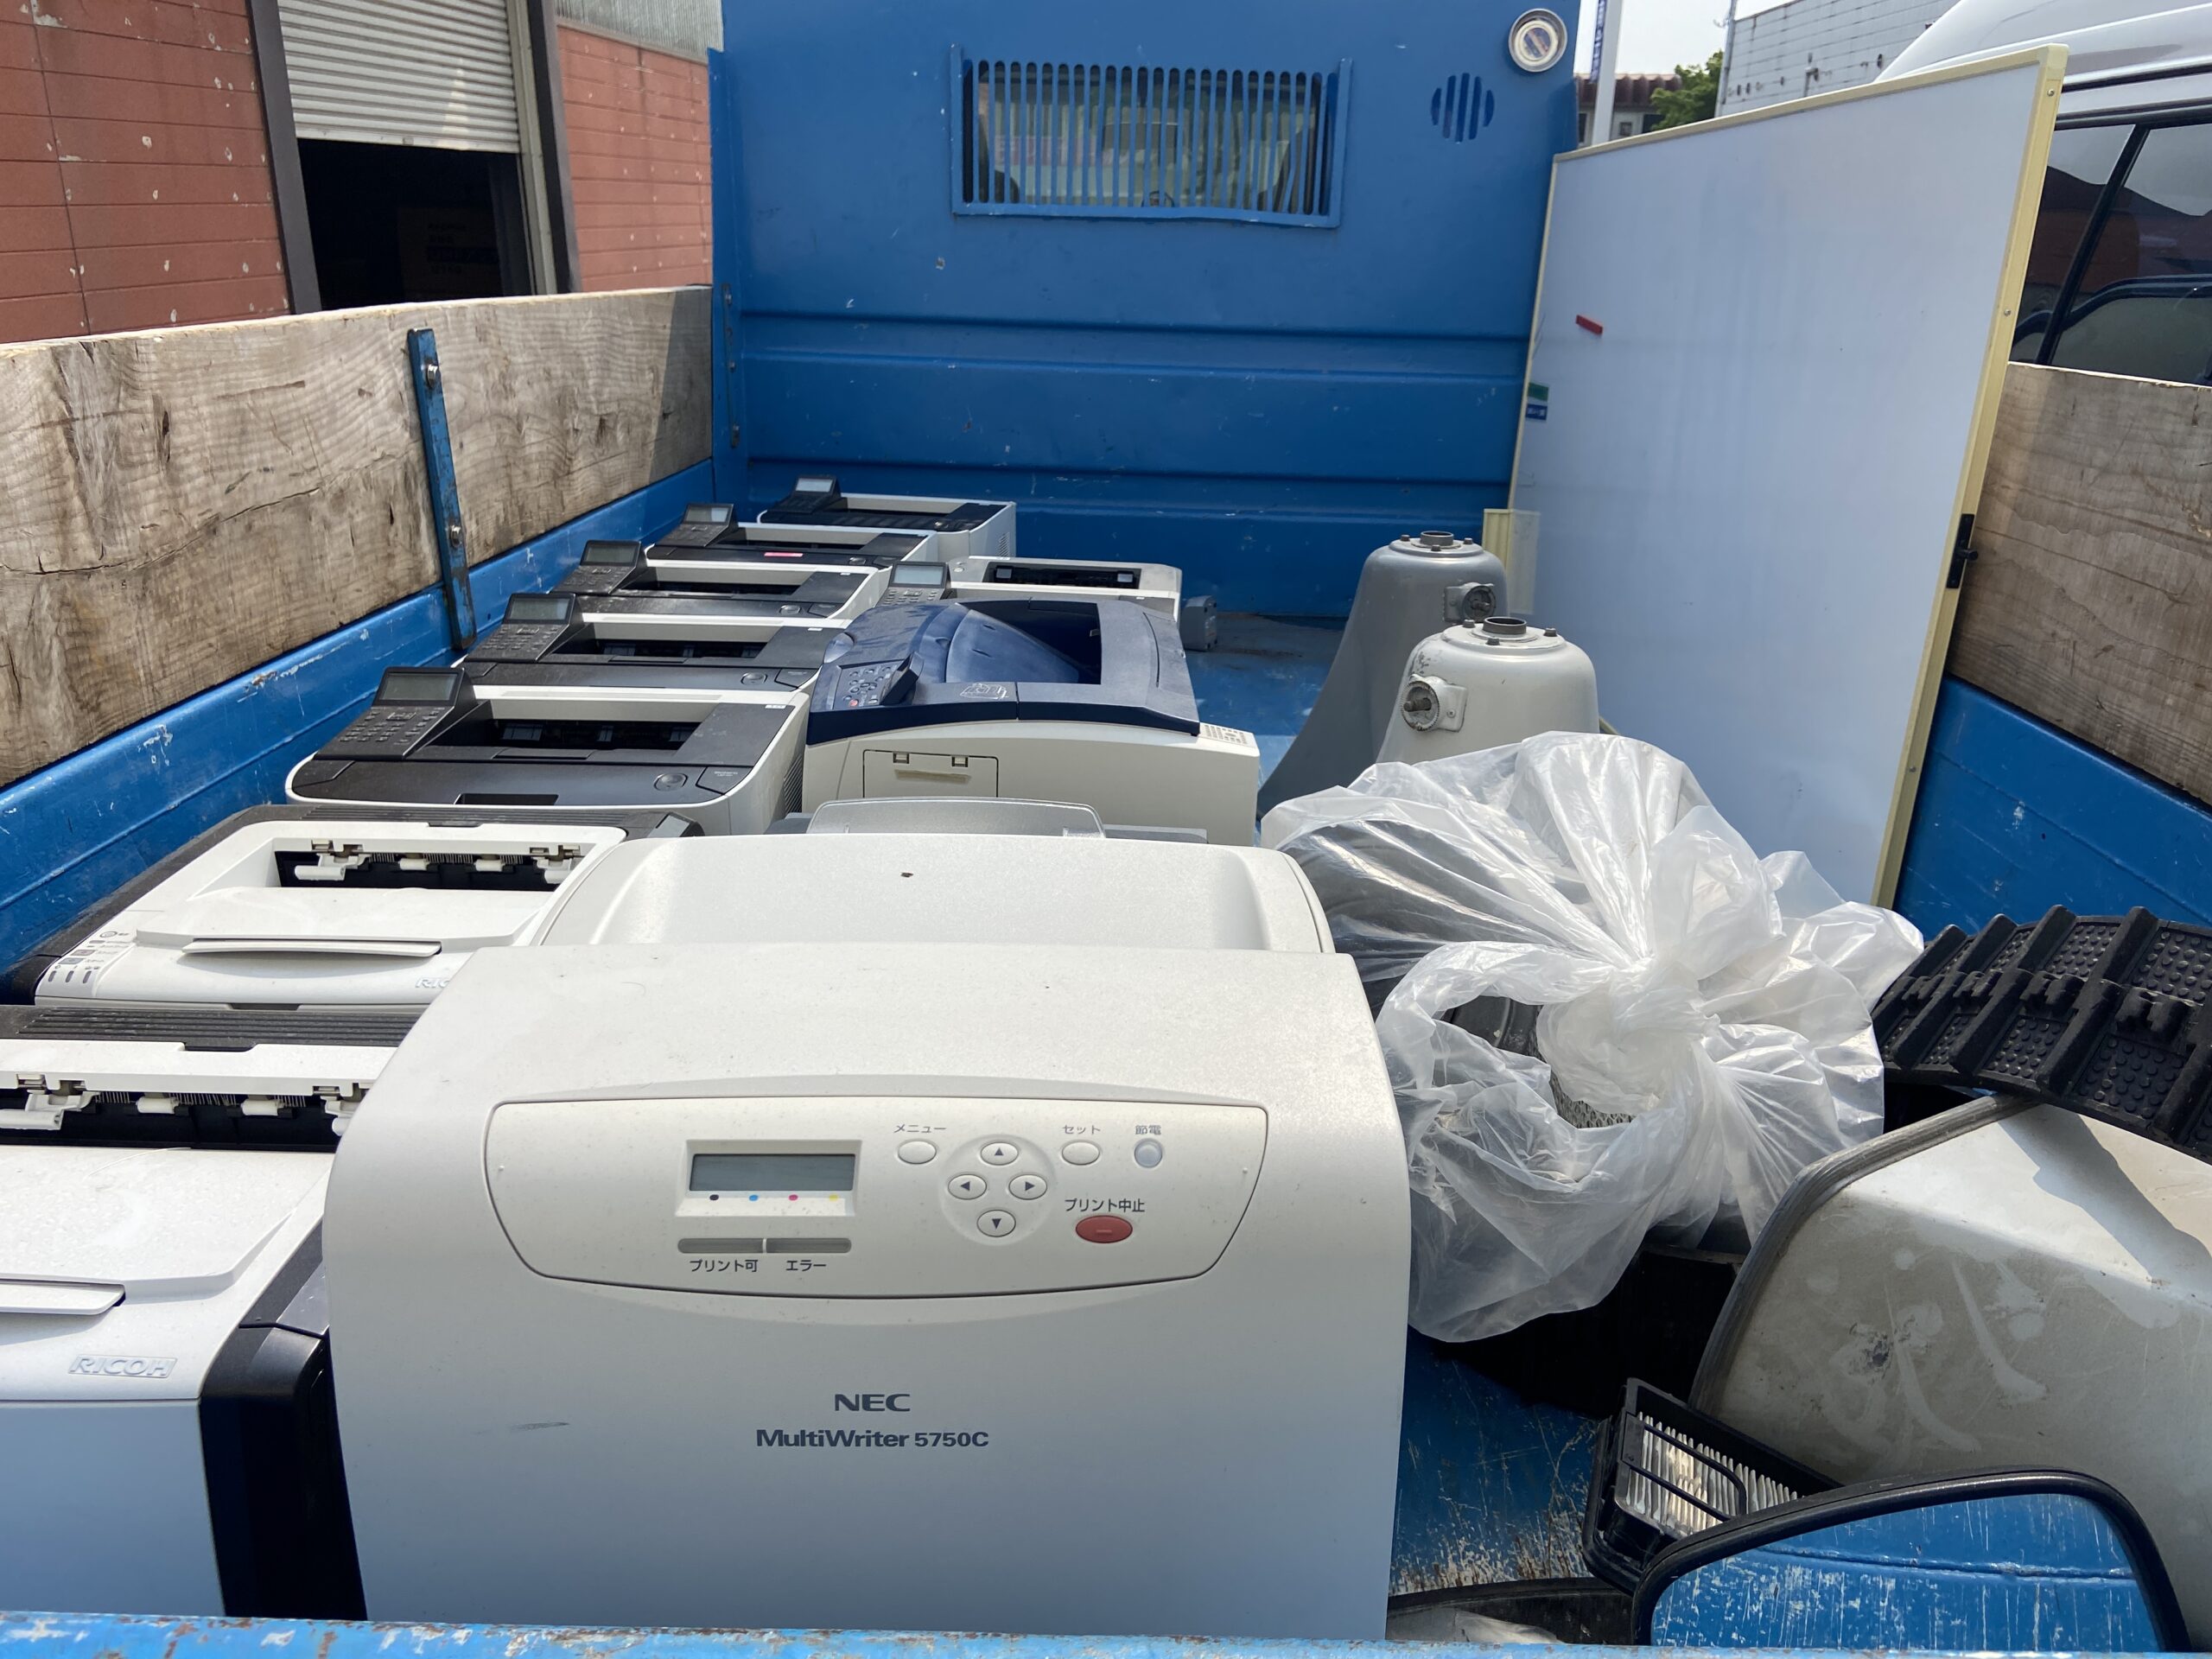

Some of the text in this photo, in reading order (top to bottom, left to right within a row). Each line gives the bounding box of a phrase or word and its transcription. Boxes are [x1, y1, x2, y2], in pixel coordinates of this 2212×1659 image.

[893, 1123, 947, 1134] メニュー
[1063, 1124, 1101, 1135] セット
[1135, 1124, 1162, 1136] 節電
[1065, 1198, 1146, 1213] プリント中止
[690, 1258, 759, 1273] プリント可
[785, 1259, 827, 1272] エラー
[68, 1356, 173, 1376] RICOH
[834, 1393, 912, 1412] NEC
[755, 1428, 989, 1448] MultiWriter 5750C
